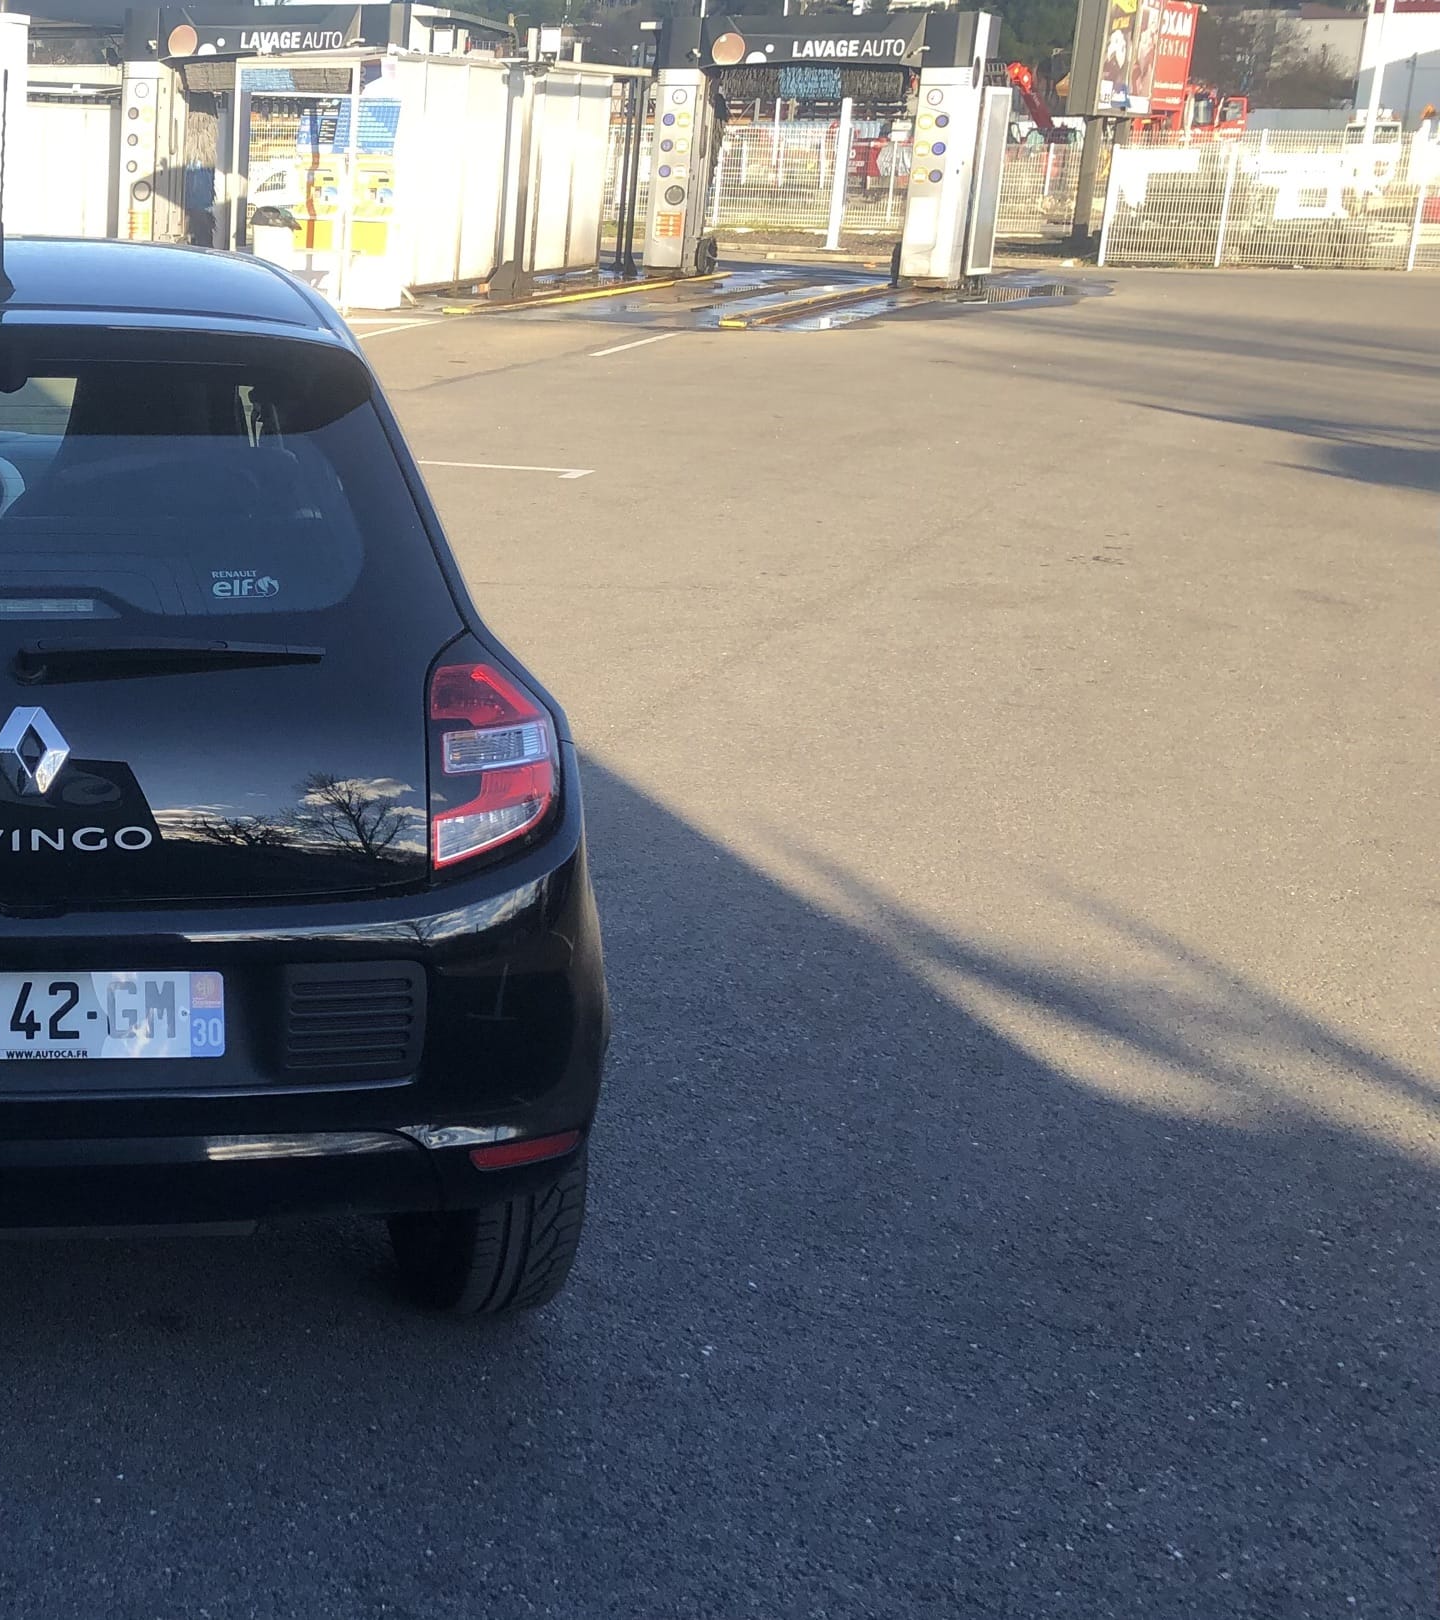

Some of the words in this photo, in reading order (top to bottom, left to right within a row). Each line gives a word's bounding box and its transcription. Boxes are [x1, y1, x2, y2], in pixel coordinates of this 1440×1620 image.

[240, 31, 301, 49] LAVAGE
[302, 31, 342, 49] AUTO
[791, 39, 860, 58] LAVAGE
[861, 38, 905, 57] AUTO
[211, 570, 257, 579] RENAULT
[212, 579, 255, 597] elf
[192, 1017, 222, 1047] 30
[6, 1050, 89, 1060] WWW.AUTOCA.FR
